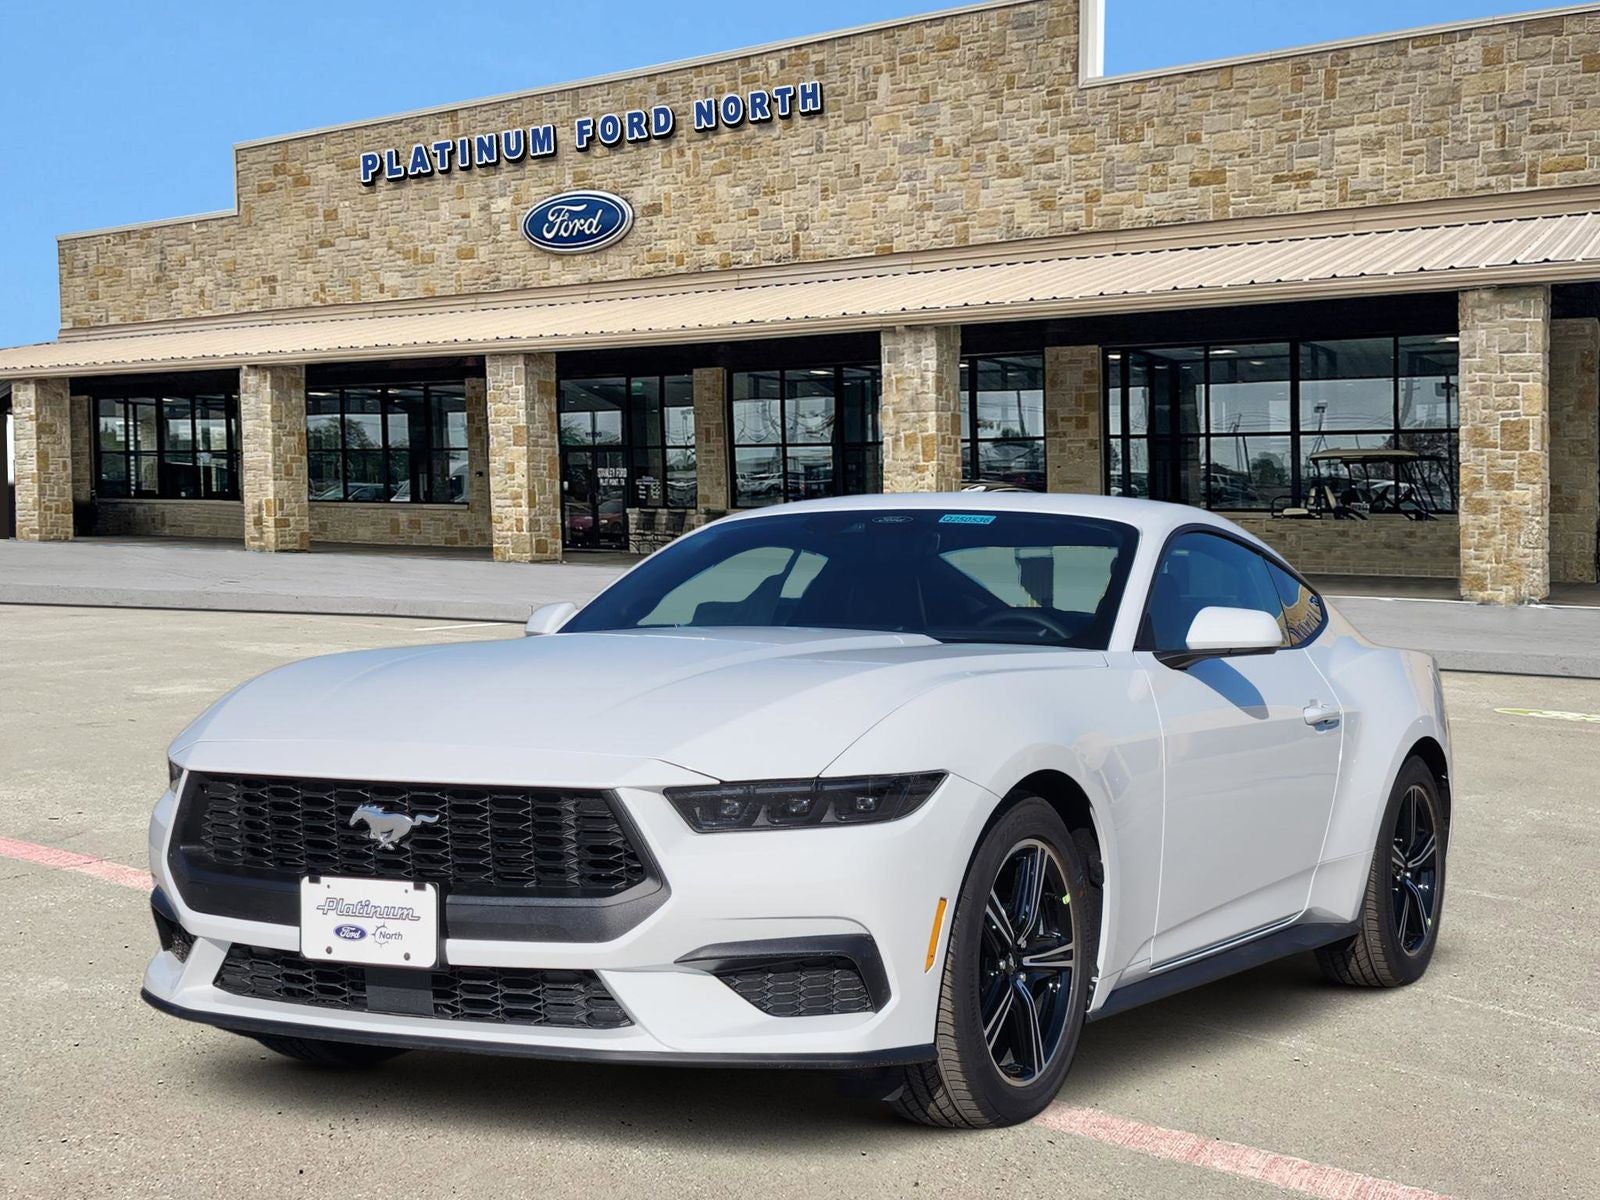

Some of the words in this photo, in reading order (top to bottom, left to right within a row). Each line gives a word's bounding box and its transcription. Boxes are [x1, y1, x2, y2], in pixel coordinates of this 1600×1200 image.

[361, 124, 557, 185] PLATINUM
[575, 104, 675, 150] FORD
[694, 81, 822, 132] NORTH
[542, 203, 602, 239] Ford
[616, 467, 628, 478] FORD
[316, 897, 421, 921] Platinum
[339, 926, 361, 939] Ford
[379, 931, 403, 940] North
